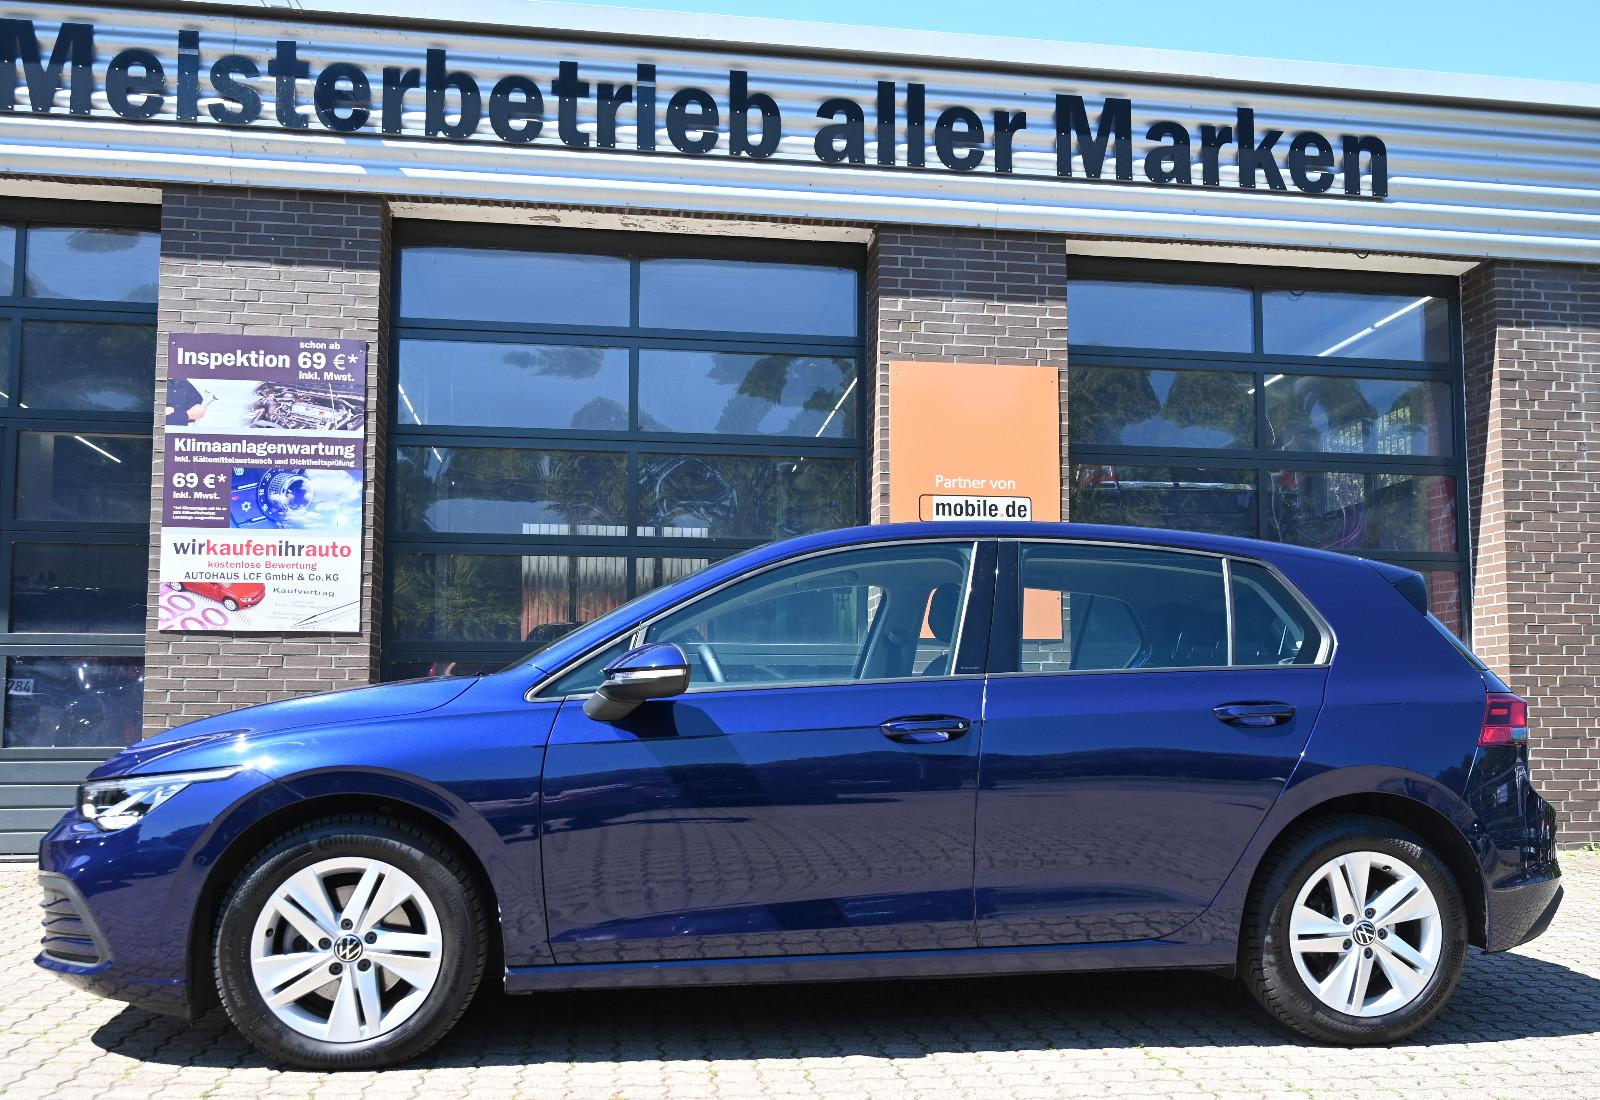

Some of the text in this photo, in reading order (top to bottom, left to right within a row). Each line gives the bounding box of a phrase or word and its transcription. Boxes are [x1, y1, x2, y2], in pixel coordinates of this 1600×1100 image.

[0, 18, 1389, 198] Meisterbetrieb aller Marken
[299, 341, 341, 351] schon ab
[177, 347, 290, 369] Inspektion
[298, 352, 326, 370] 69
[324, 371, 355, 382] Mwst.
[174, 437, 356, 459] Klimaanlagenwartung
[193, 455, 273, 466] Kältemittelaustausch
[275, 458, 289, 466] und
[290, 458, 356, 469] Dichtheitsprüfung
[172, 472, 199, 489] 69
[935, 475, 1016, 490] Partner von
[194, 491, 220, 500] Mwst.
[935, 500, 1028, 518] mobile.de
[173, 538, 352, 558] wirkaufenihrauto
[207, 560, 318, 571] kostenlose Bewertung
[184, 571, 240, 581] AUTOHAUS
[243, 572, 262, 581] LCF
[265, 572, 294, 582] GmbH
[297, 573, 305, 582] &
[273, 587, 335, 598] Kaufvertrag
